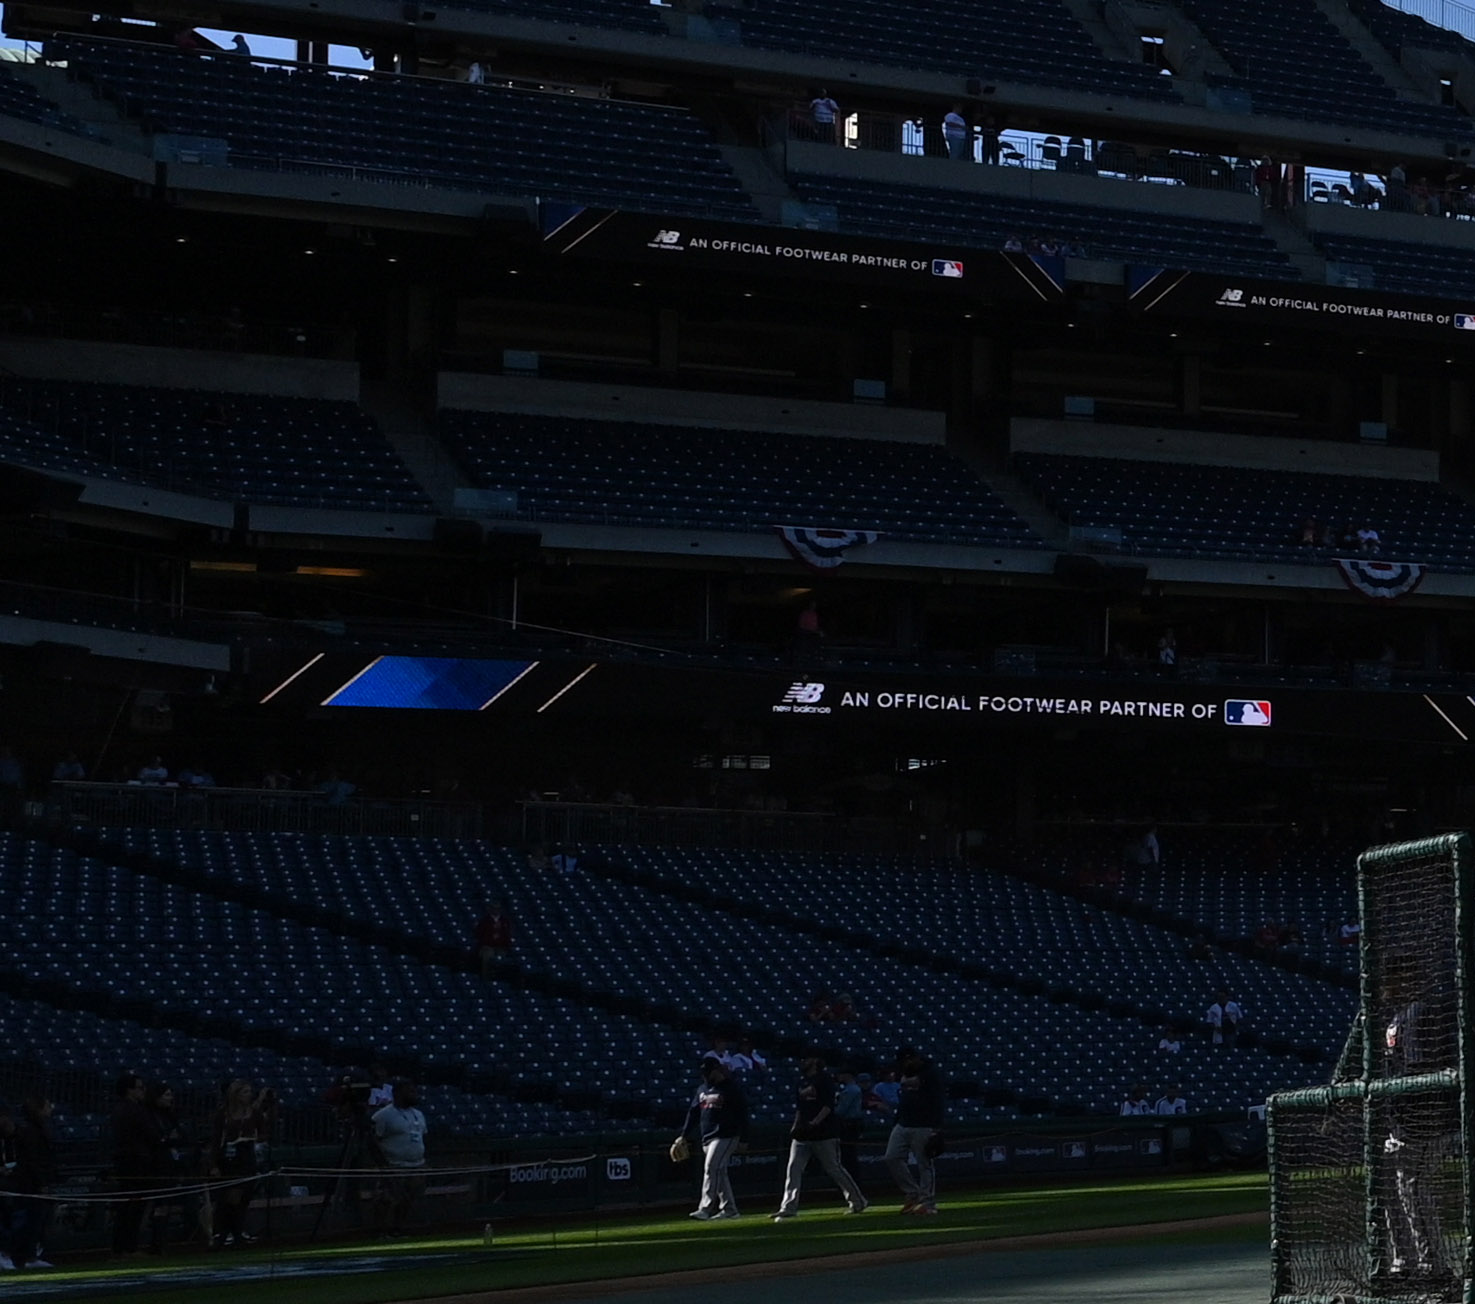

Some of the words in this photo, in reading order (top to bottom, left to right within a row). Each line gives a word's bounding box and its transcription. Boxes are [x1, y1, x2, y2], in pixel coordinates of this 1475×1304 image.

[689, 237, 708, 249] AN
[711, 239, 771, 256] OFFICIAL
[775, 245, 848, 264] FOOTWEAR
[851, 253, 907, 269] PARTNER
[910, 260, 929, 272] OF
[1250, 295, 1267, 306] AN
[1269, 296, 1320, 312] OFFICIAL
[1323, 302, 1384, 318] FOOTWEAR
[1386, 308, 1434, 324] PARTNER
[1436, 314, 1451, 325] OF
[840, 692, 869, 709] AN
[876, 692, 971, 711] OFFICIAL
[978, 696, 1093, 714] FOOTWEAR
[1099, 700, 1185, 718] PARTNER
[1191, 703, 1218, 720] OF
[509, 1163, 587, 1185] Booking.com
[608, 1159, 630, 1180] tbs
